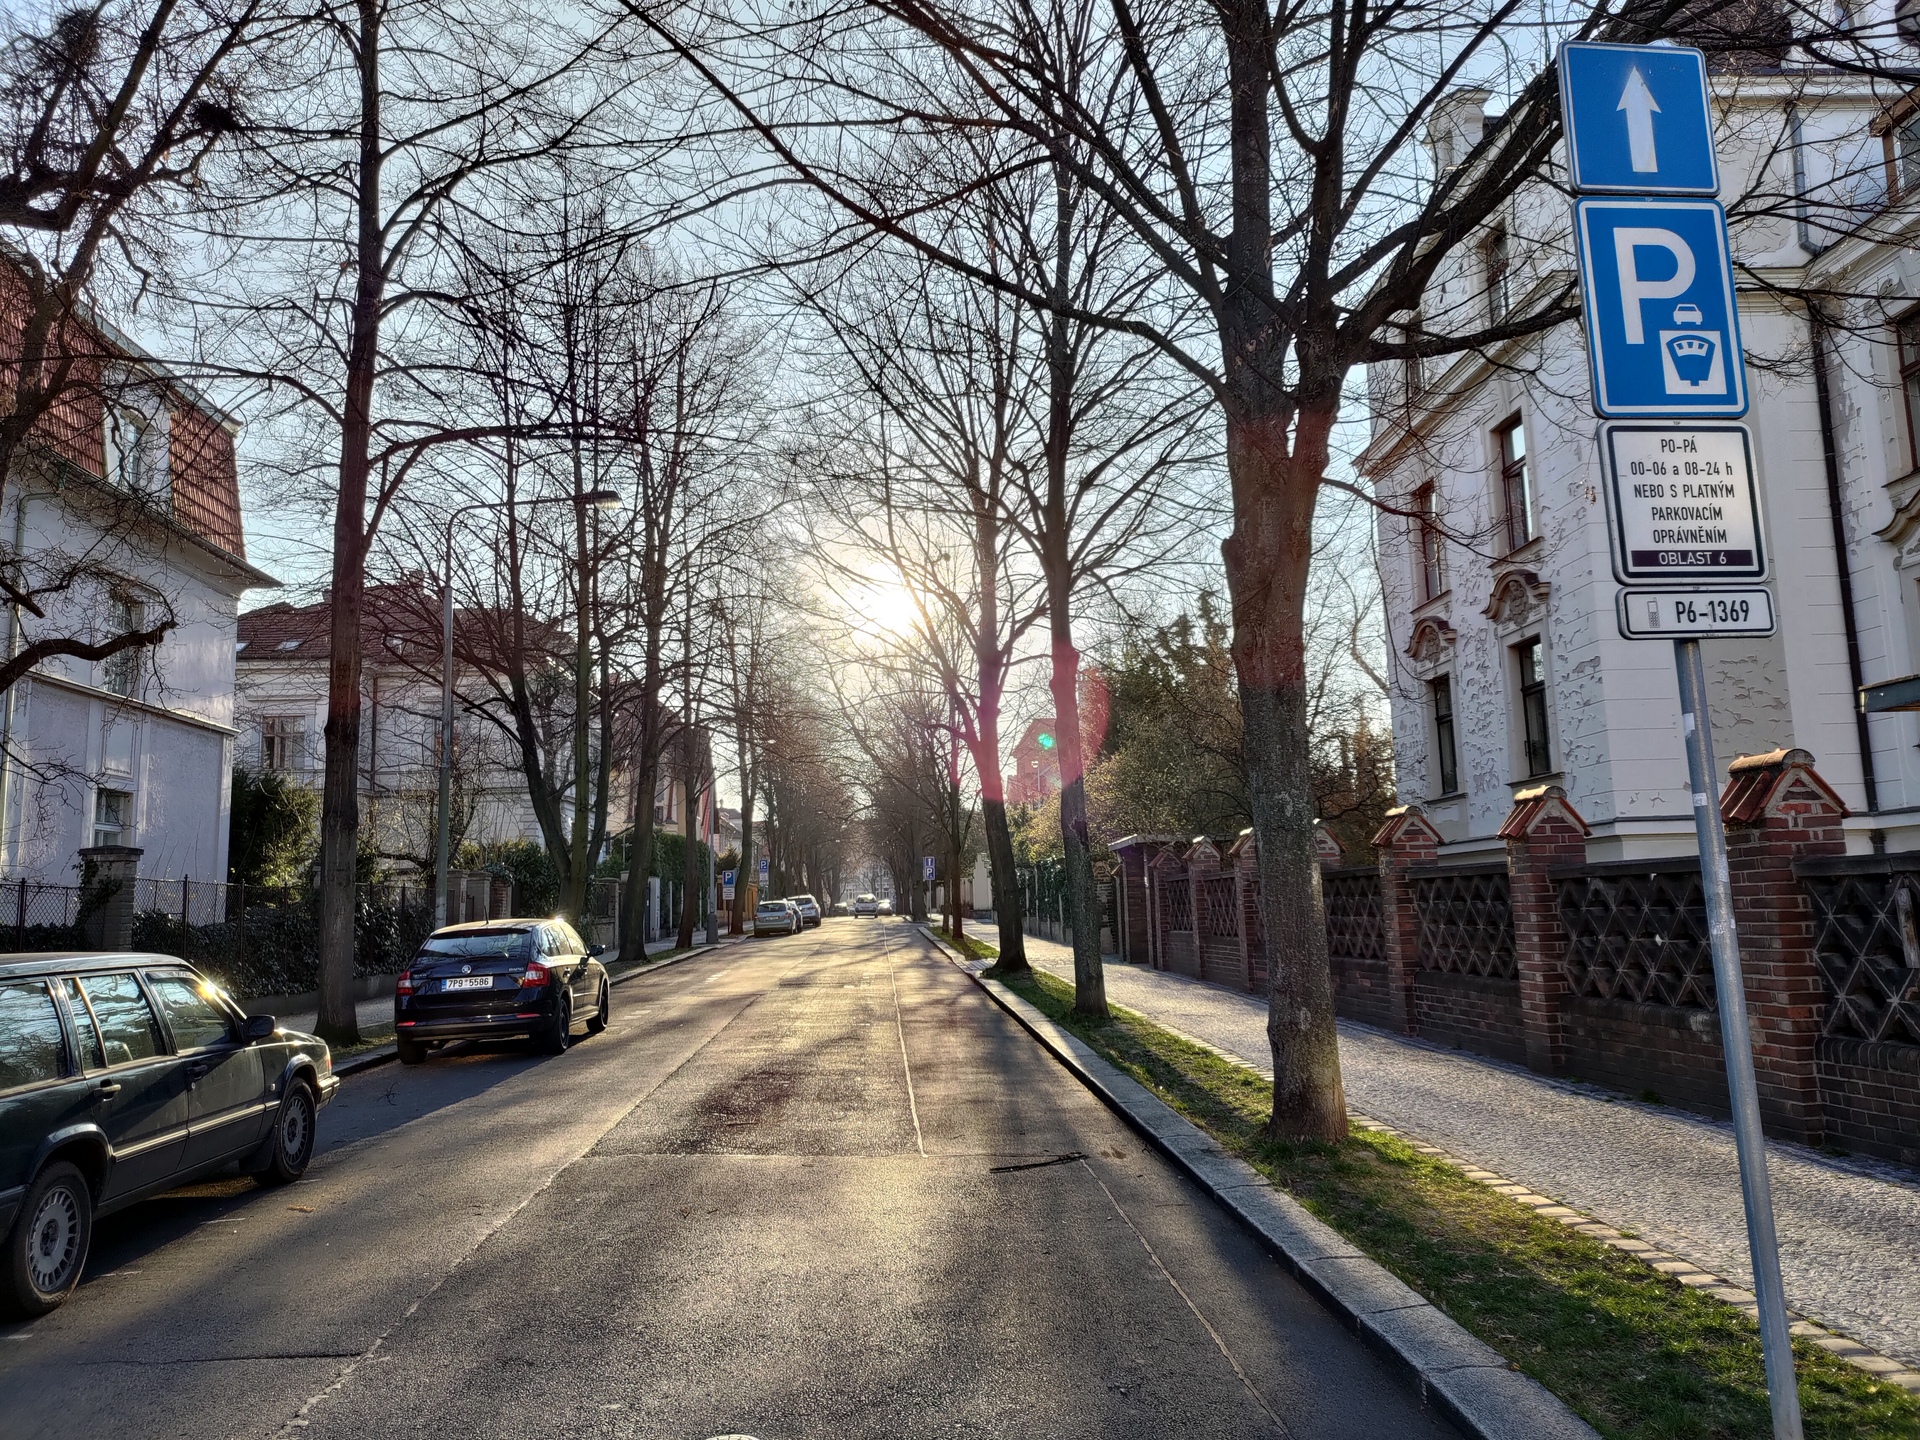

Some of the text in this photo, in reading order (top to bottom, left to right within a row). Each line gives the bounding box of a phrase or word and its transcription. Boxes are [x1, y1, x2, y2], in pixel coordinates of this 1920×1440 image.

[1613, 227, 1697, 345] P
[1660, 435, 1698, 453] PO-PÁ
[1630, 461, 1733, 476] 00-06 a 08-24 h
[1633, 480, 1735, 498] NEBO S PLATNÝM
[1651, 502, 1723, 521] PARKOVACÍM
[1653, 526, 1727, 544] OPRÁVNĚNÍM
[1659, 552, 1727, 565] OBLAST 6
[1675, 599, 1750, 624] P6-1369
[725, 872, 732, 882] P
[926, 867, 933, 877] P
[448, 980, 464, 989] 7P9
[469, 978, 489, 987] 5586
